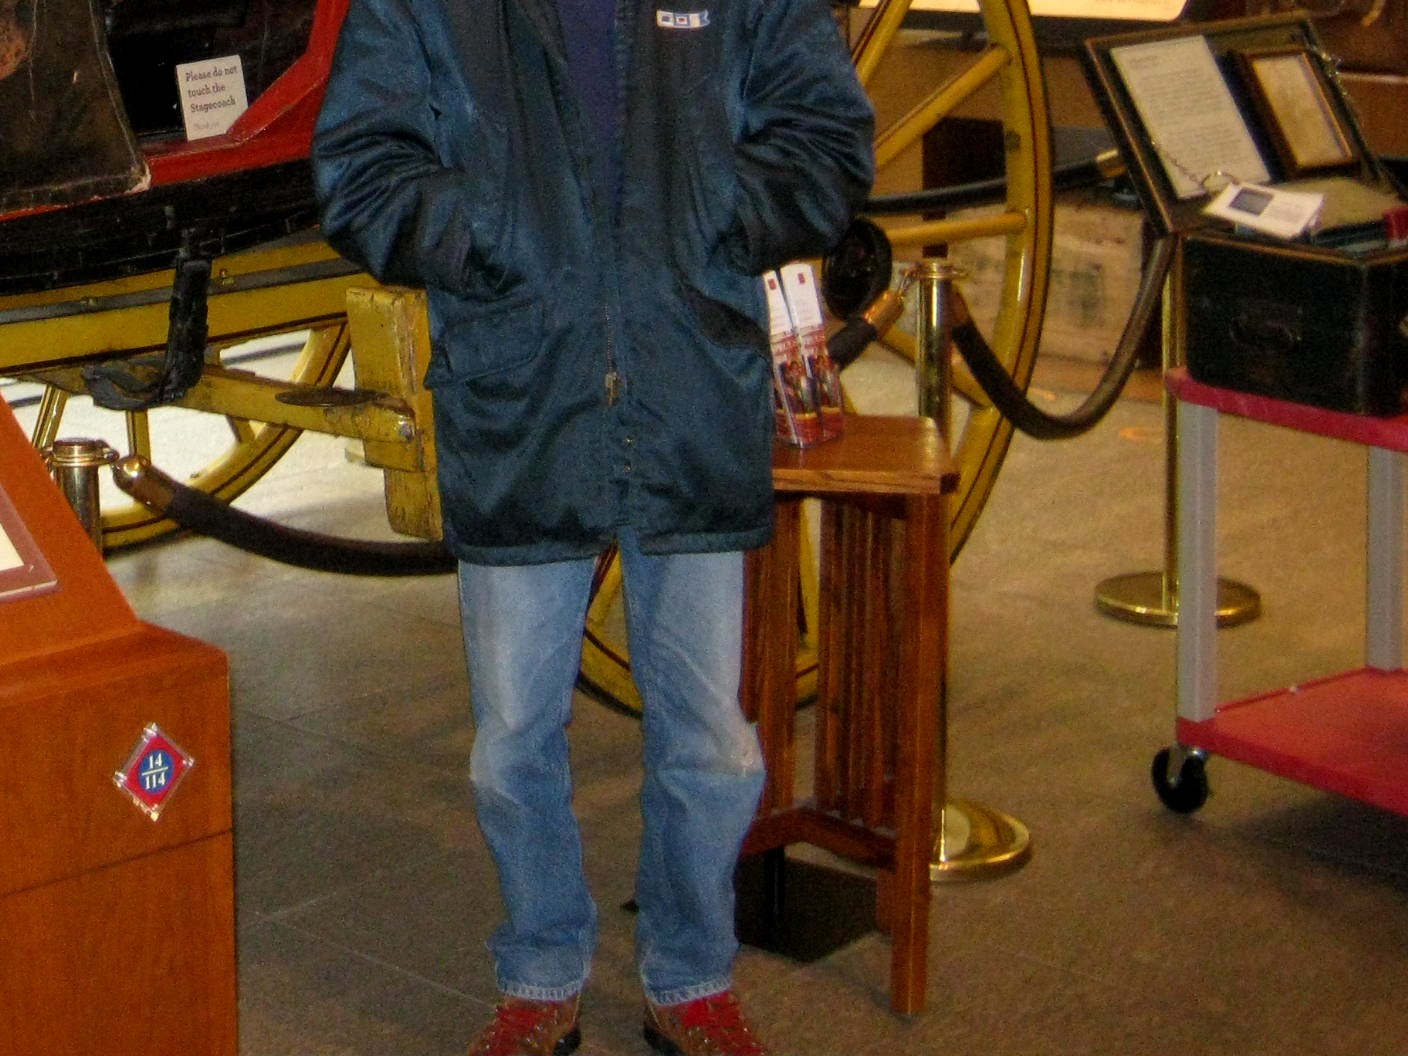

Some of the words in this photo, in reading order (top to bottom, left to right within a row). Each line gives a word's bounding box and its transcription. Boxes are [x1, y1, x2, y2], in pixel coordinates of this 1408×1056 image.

[185, 70, 212, 82] Please
[212, 66, 223, 77] do
[224, 65, 238, 76] not
[188, 84, 211, 97] touch
[212, 81, 226, 93] the
[190, 95, 236, 113] Stagecoach
[149, 752, 162, 769] 14
[145, 771, 166, 790] 114
